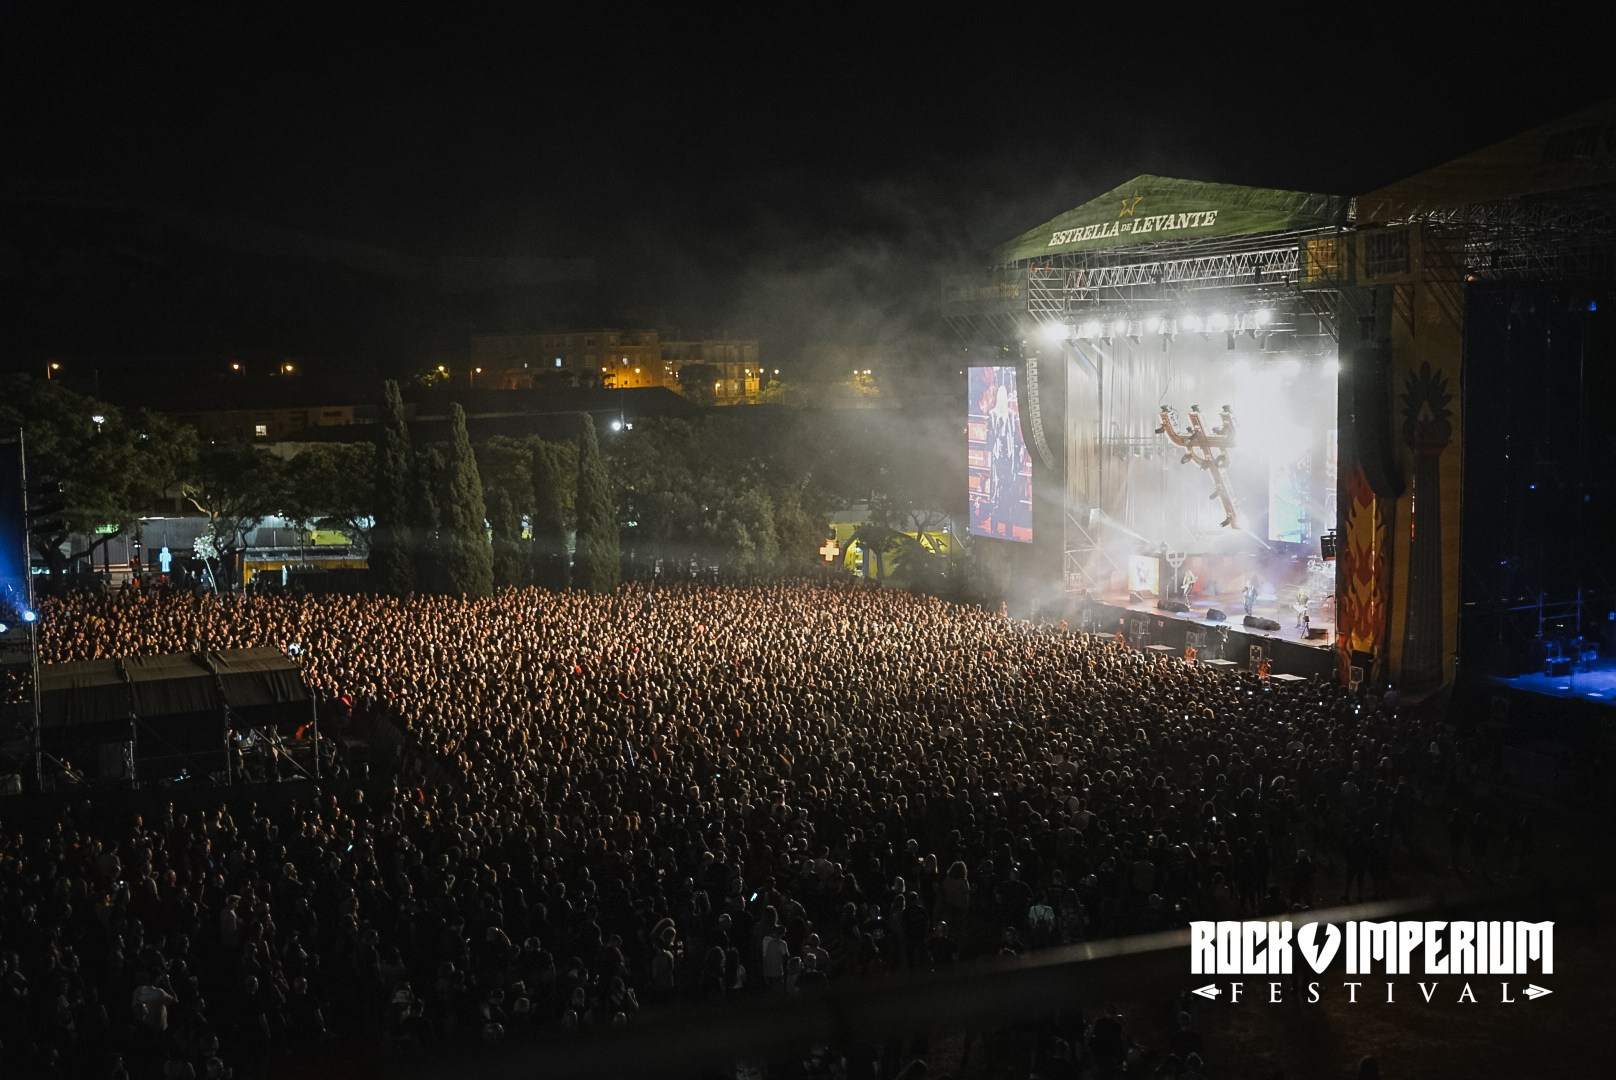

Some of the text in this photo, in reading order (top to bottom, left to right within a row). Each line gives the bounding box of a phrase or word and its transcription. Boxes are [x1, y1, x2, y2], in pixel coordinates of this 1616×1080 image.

[1048, 210, 1219, 246] ESTRELLA DE LEVANTE
